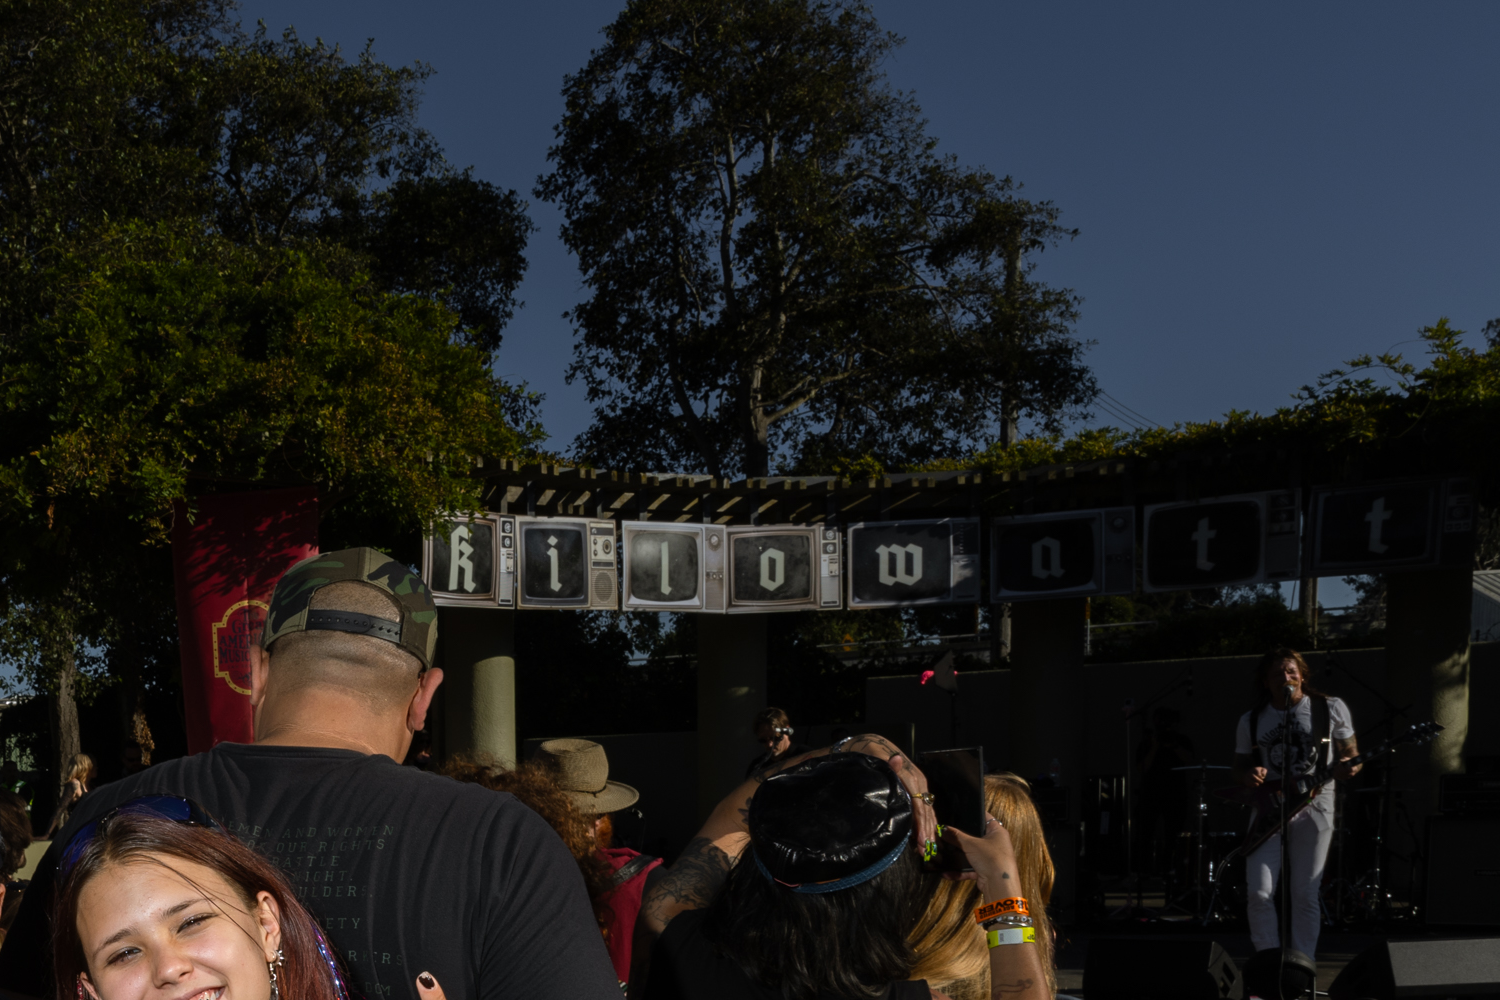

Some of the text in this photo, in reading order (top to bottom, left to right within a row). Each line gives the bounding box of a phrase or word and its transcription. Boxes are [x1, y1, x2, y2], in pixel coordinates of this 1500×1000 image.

[282, 826, 317, 838] AND
[328, 825, 394, 838] WOMEN
[276, 841, 307, 853] OUR
[318, 838, 386, 853] RIGHTS
[979, 899, 1014, 915] OVER
